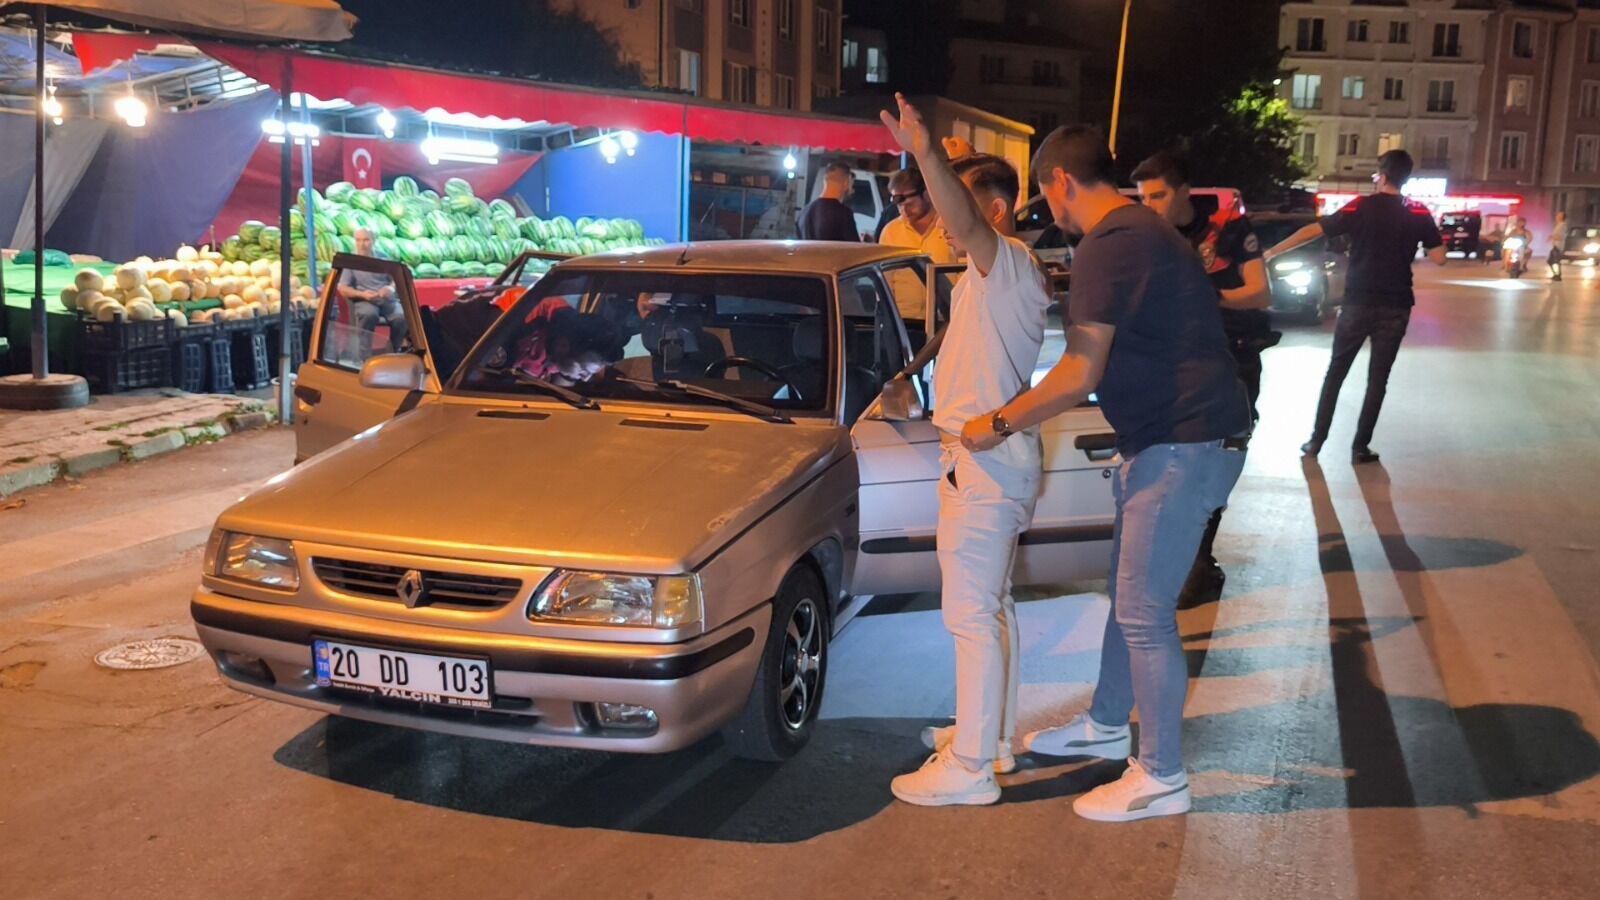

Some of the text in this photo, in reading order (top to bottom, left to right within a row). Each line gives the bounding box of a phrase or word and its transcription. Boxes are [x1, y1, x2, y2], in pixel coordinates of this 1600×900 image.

[319, 661, 330, 672] TR
[332, 647, 484, 694] 20 DD 103
